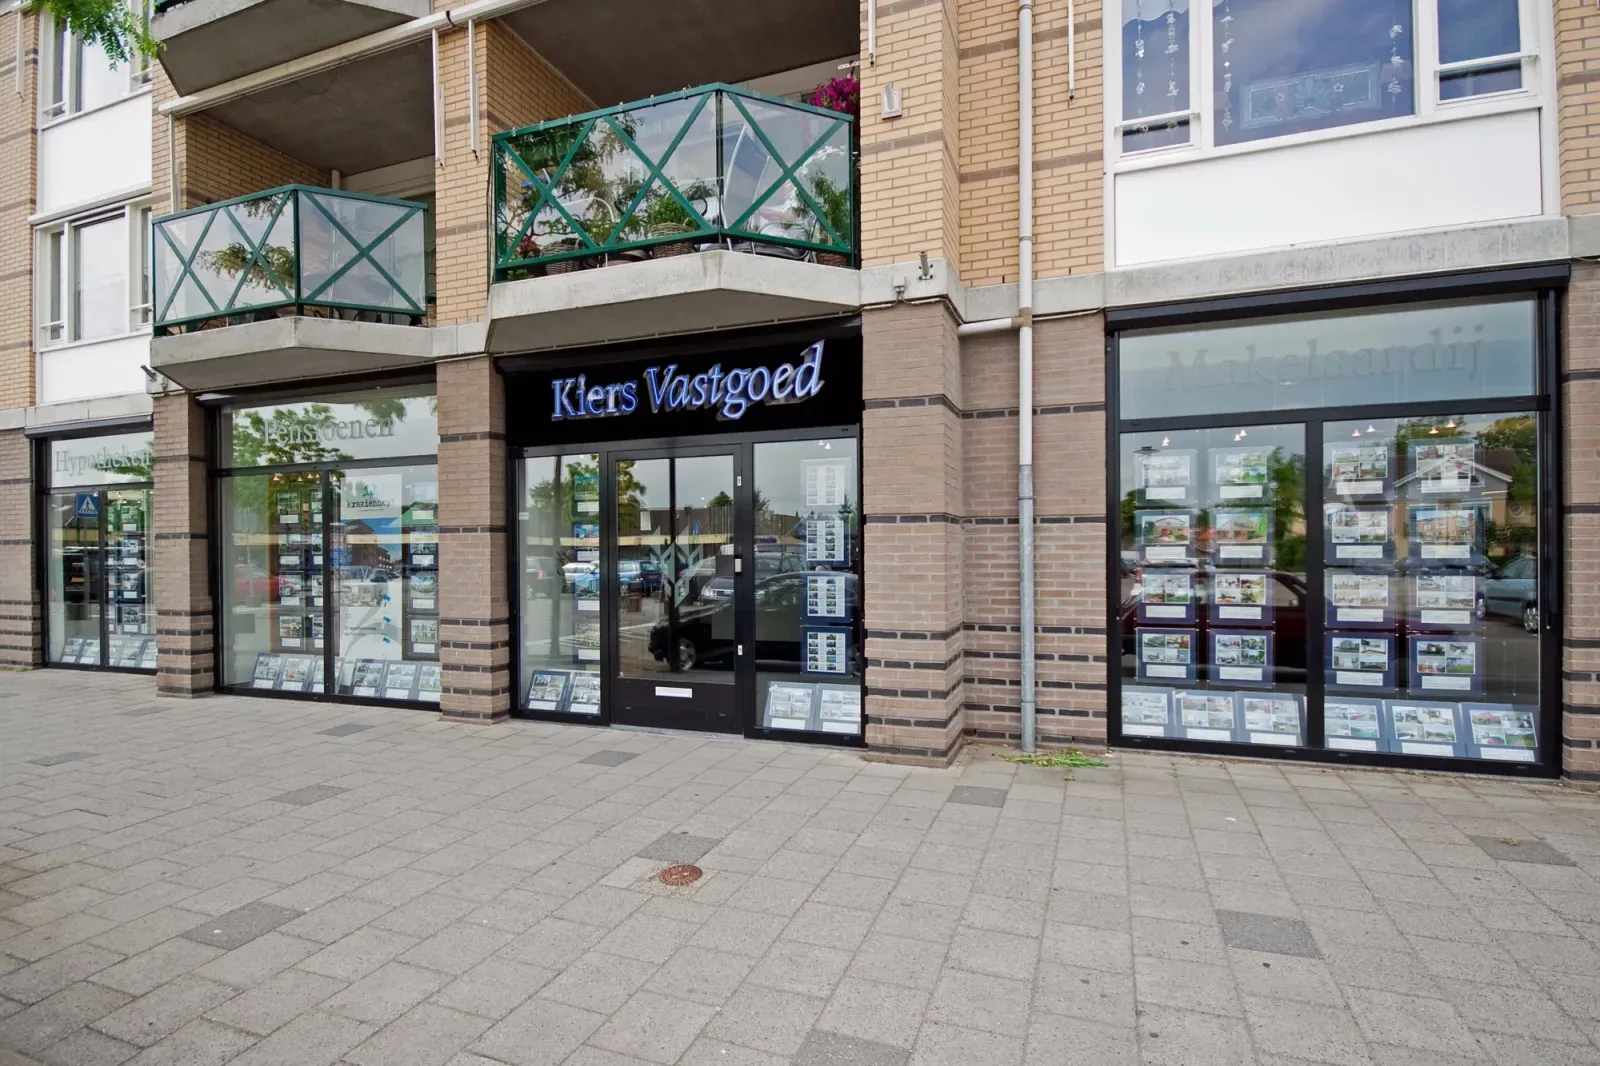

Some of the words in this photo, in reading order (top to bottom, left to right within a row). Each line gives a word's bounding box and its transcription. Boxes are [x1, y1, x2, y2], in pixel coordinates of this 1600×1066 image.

[551, 373, 638, 421] Kiers
[643, 340, 826, 421] Vastgoed
[1165, 324, 1485, 390] Makelaardij
[54, 445, 151, 477] Hypotheken
